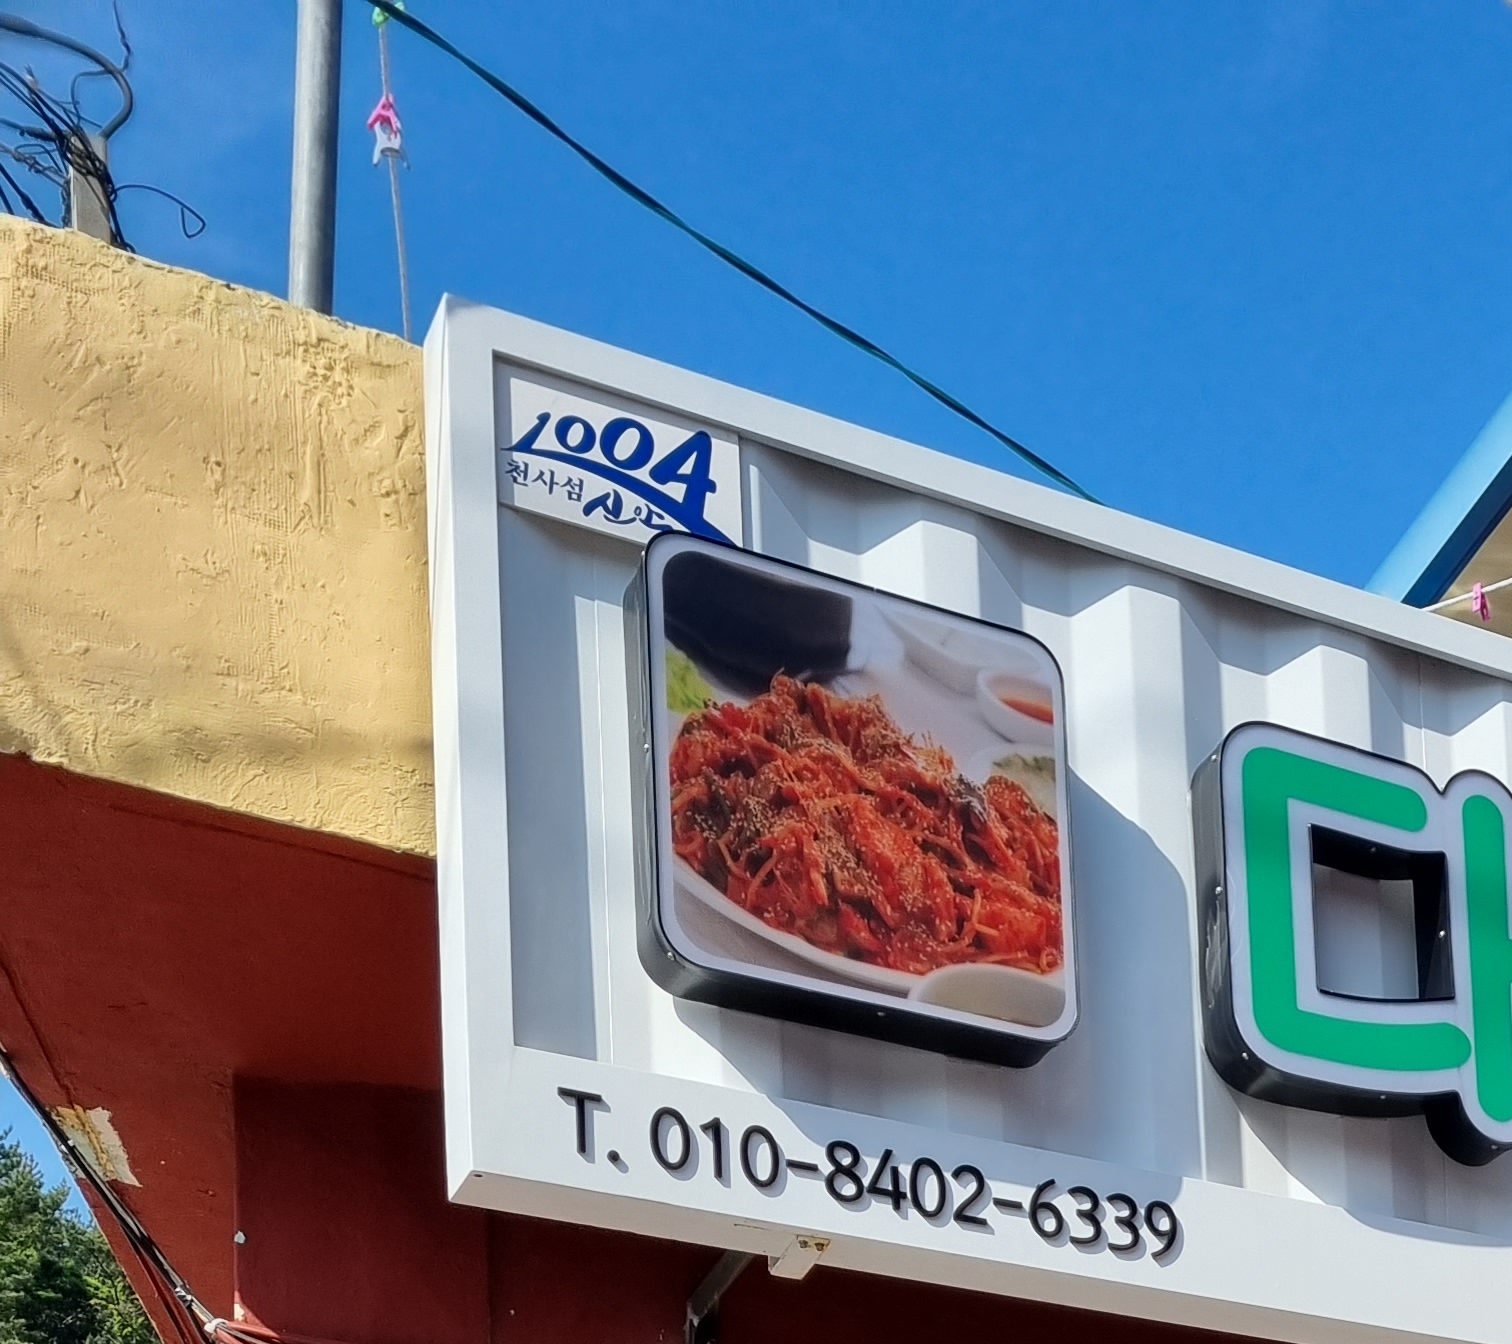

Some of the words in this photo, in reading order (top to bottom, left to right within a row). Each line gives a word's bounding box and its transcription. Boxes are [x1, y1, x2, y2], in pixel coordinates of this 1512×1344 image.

[500, 411, 717, 522] 1004
[505, 459, 585, 502] 천사섬
[557, 1086, 622, 1164] T.
[649, 1106, 1180, 1260] 010-8402-6339
